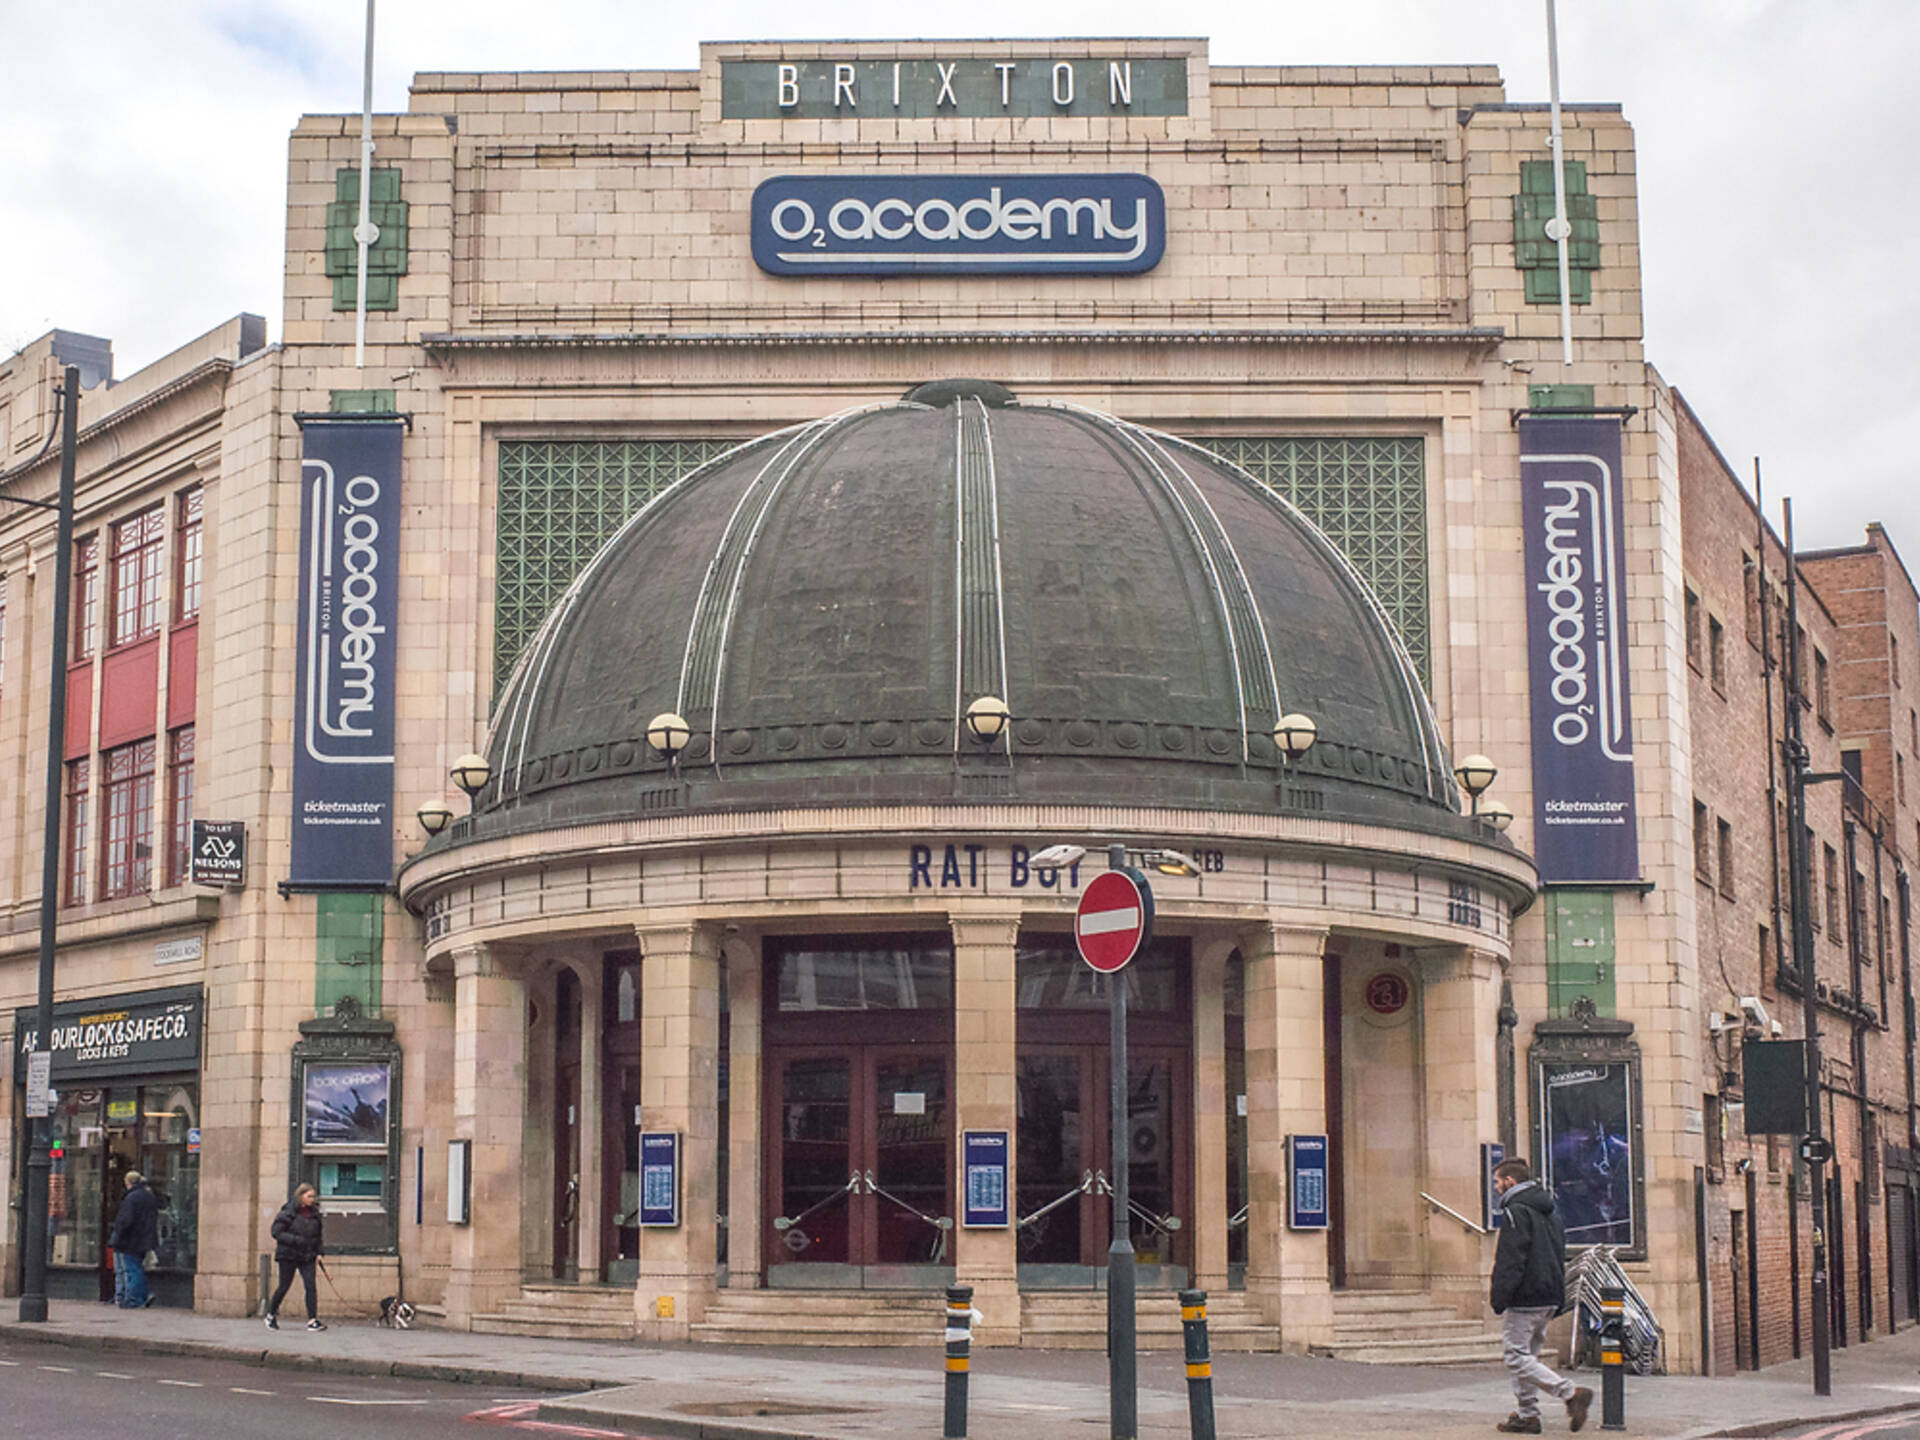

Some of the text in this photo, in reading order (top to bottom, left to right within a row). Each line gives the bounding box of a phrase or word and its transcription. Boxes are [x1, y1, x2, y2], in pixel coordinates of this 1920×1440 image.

[778, 61, 1132, 108] BRIXTON
[321, 580, 332, 630] BRIXTON
[1594, 586, 1605, 636] BRIXTON
[304, 800, 381, 813] ticketmaster
[1545, 800, 1625, 812] ticketmaster
[217, 825, 232, 833] LET
[194, 857, 242, 870] NELSONS
[911, 845, 985, 888] RAT
[77, 1048, 101, 1061] LOCKS
[109, 1044, 130, 1057] KEYS
[313, 1071, 382, 1088] box office
